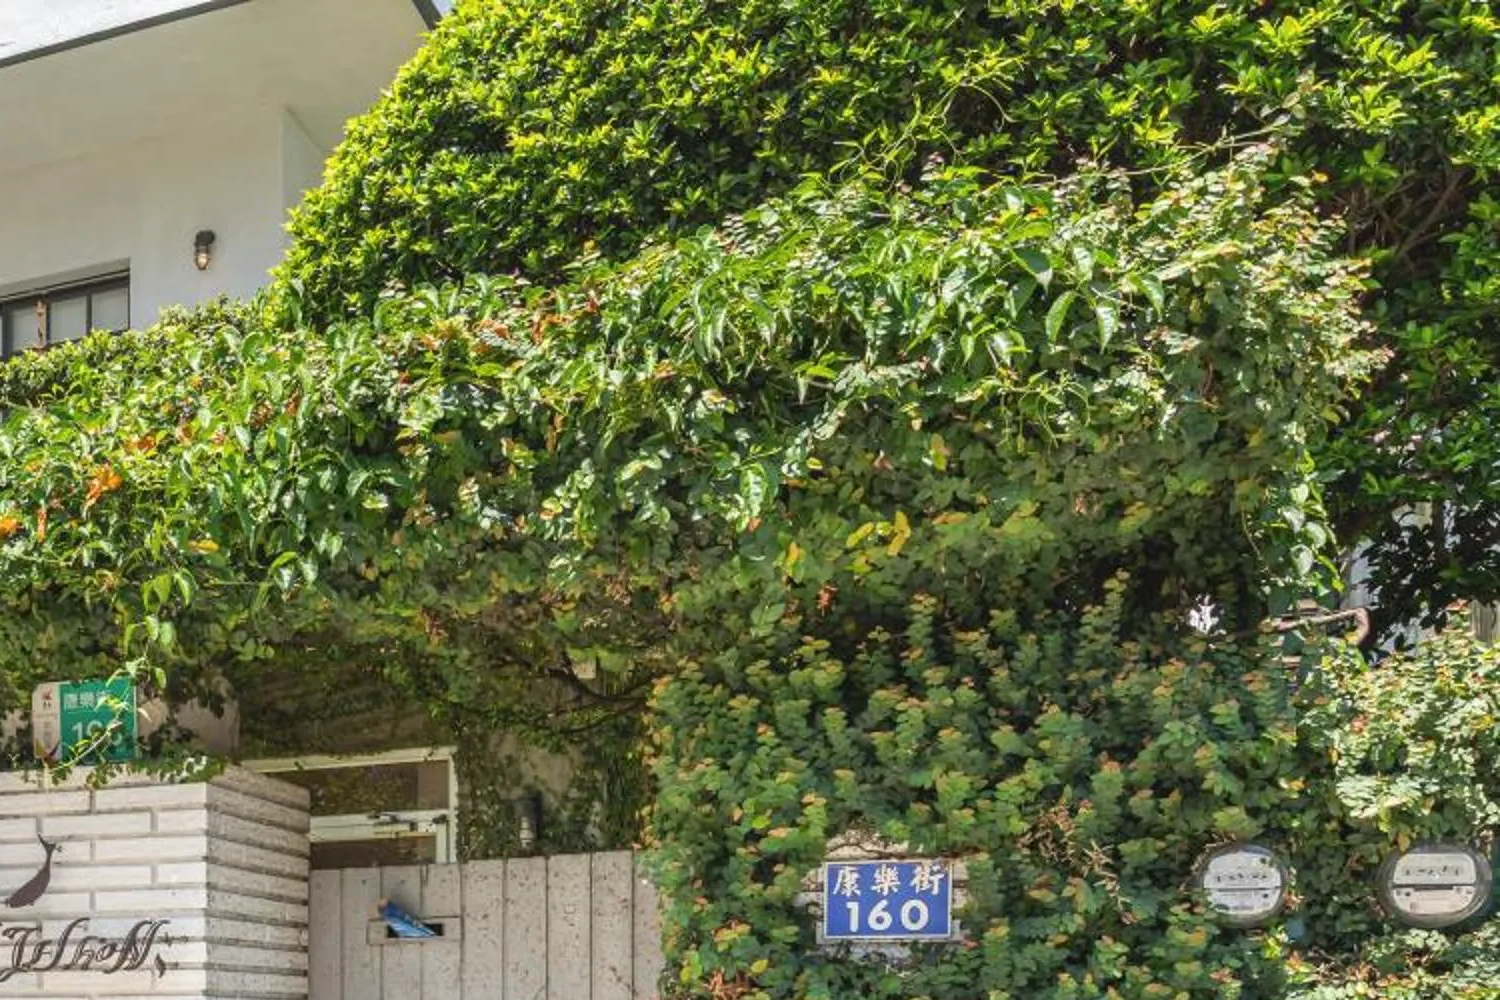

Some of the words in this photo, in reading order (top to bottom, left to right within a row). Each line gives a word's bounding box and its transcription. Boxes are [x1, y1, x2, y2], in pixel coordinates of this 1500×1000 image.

[832, 863, 945, 896] 康樂街
[845, 899, 930, 933] 160
